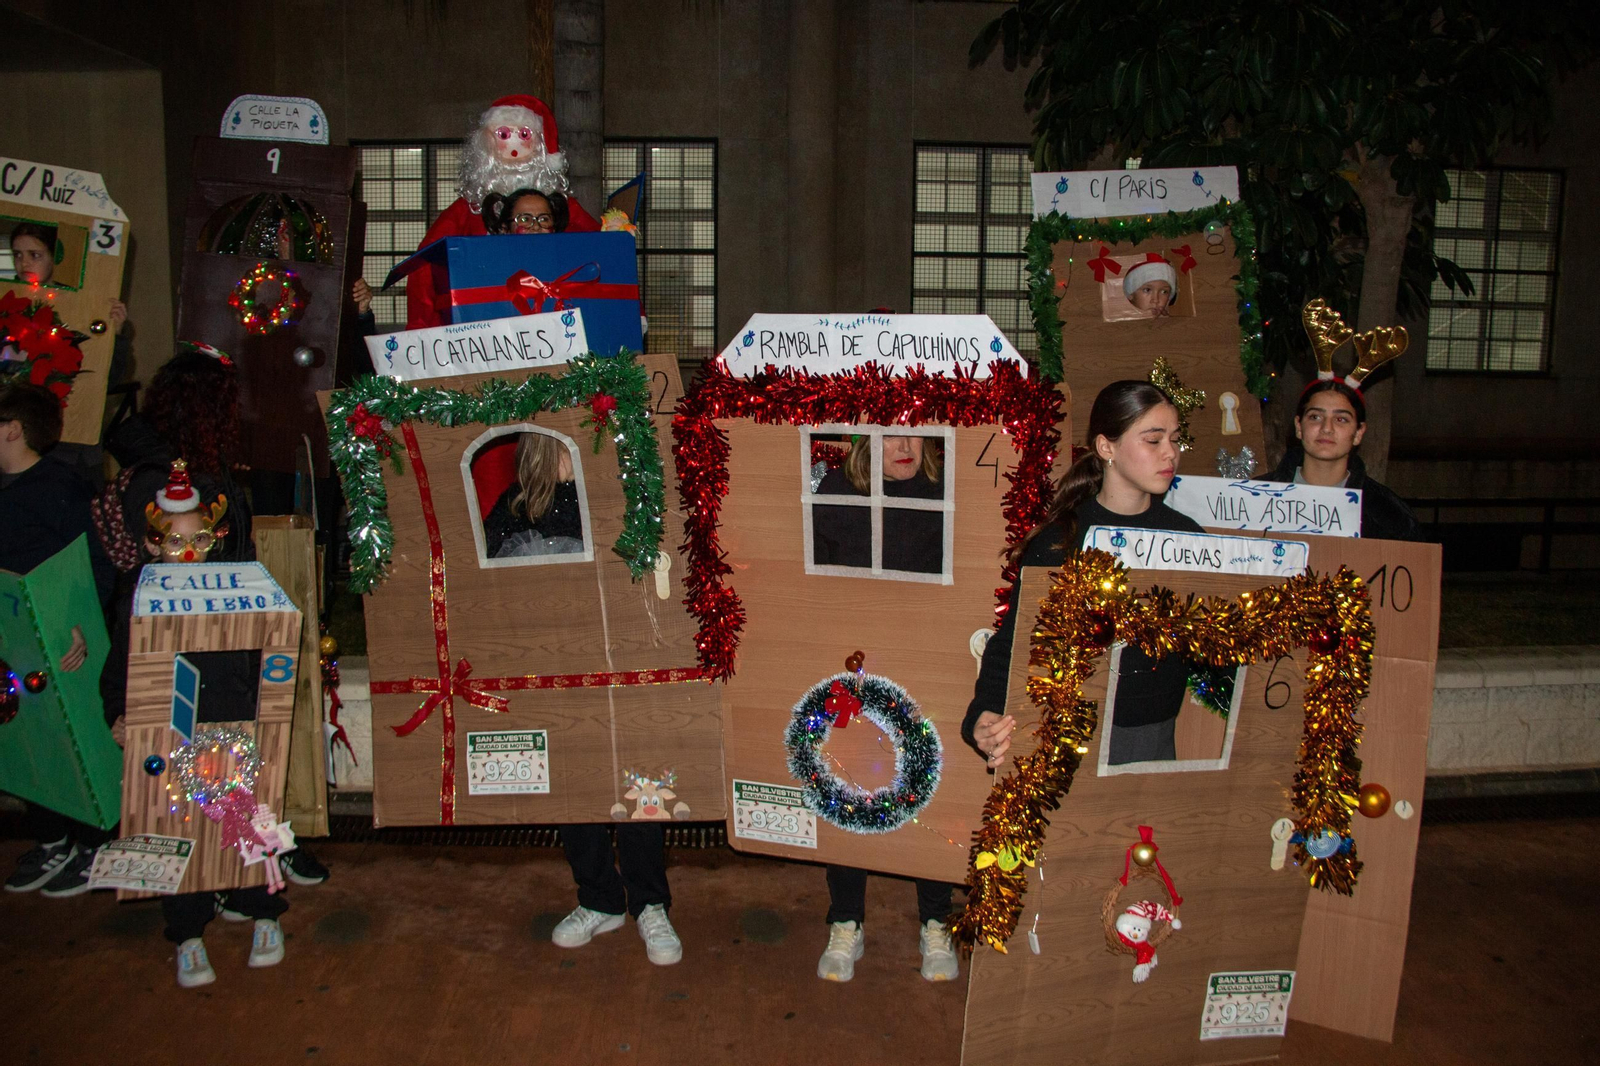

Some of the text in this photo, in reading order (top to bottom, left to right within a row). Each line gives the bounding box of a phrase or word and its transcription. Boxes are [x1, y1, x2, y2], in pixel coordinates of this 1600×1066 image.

[249, 105, 300, 117] CALLE LA
[250, 117, 300, 130] PIQUETA
[266, 148, 281, 174] 9
[1, 162, 37, 195] C/
[96, 224, 116, 249] 3
[1206, 233, 1225, 255] 8
[433, 330, 555, 367] CATALANES
[760, 330, 981, 363] RAMBLA DE CAPUCHINOS
[652, 370, 678, 415] 2
[975, 432, 999, 488] 4
[1161, 537, 1222, 569] CUEVAS
[160, 572, 245, 591] CALLE
[1366, 564, 1413, 612] 10
[150, 595, 267, 613] RIO EBRO
[262, 654, 294, 683] 8
[1264, 654, 1294, 709] 6
[493, 734, 533, 742] SILVESTRE
[485, 760, 532, 781] 926
[742, 784, 802, 798] SAN SILVESTRE
[751, 810, 799, 834] 923
[112, 858, 166, 879] 929
[1238, 975, 1279, 983] SILVESTRE
[1220, 1001, 1270, 1025] 925
